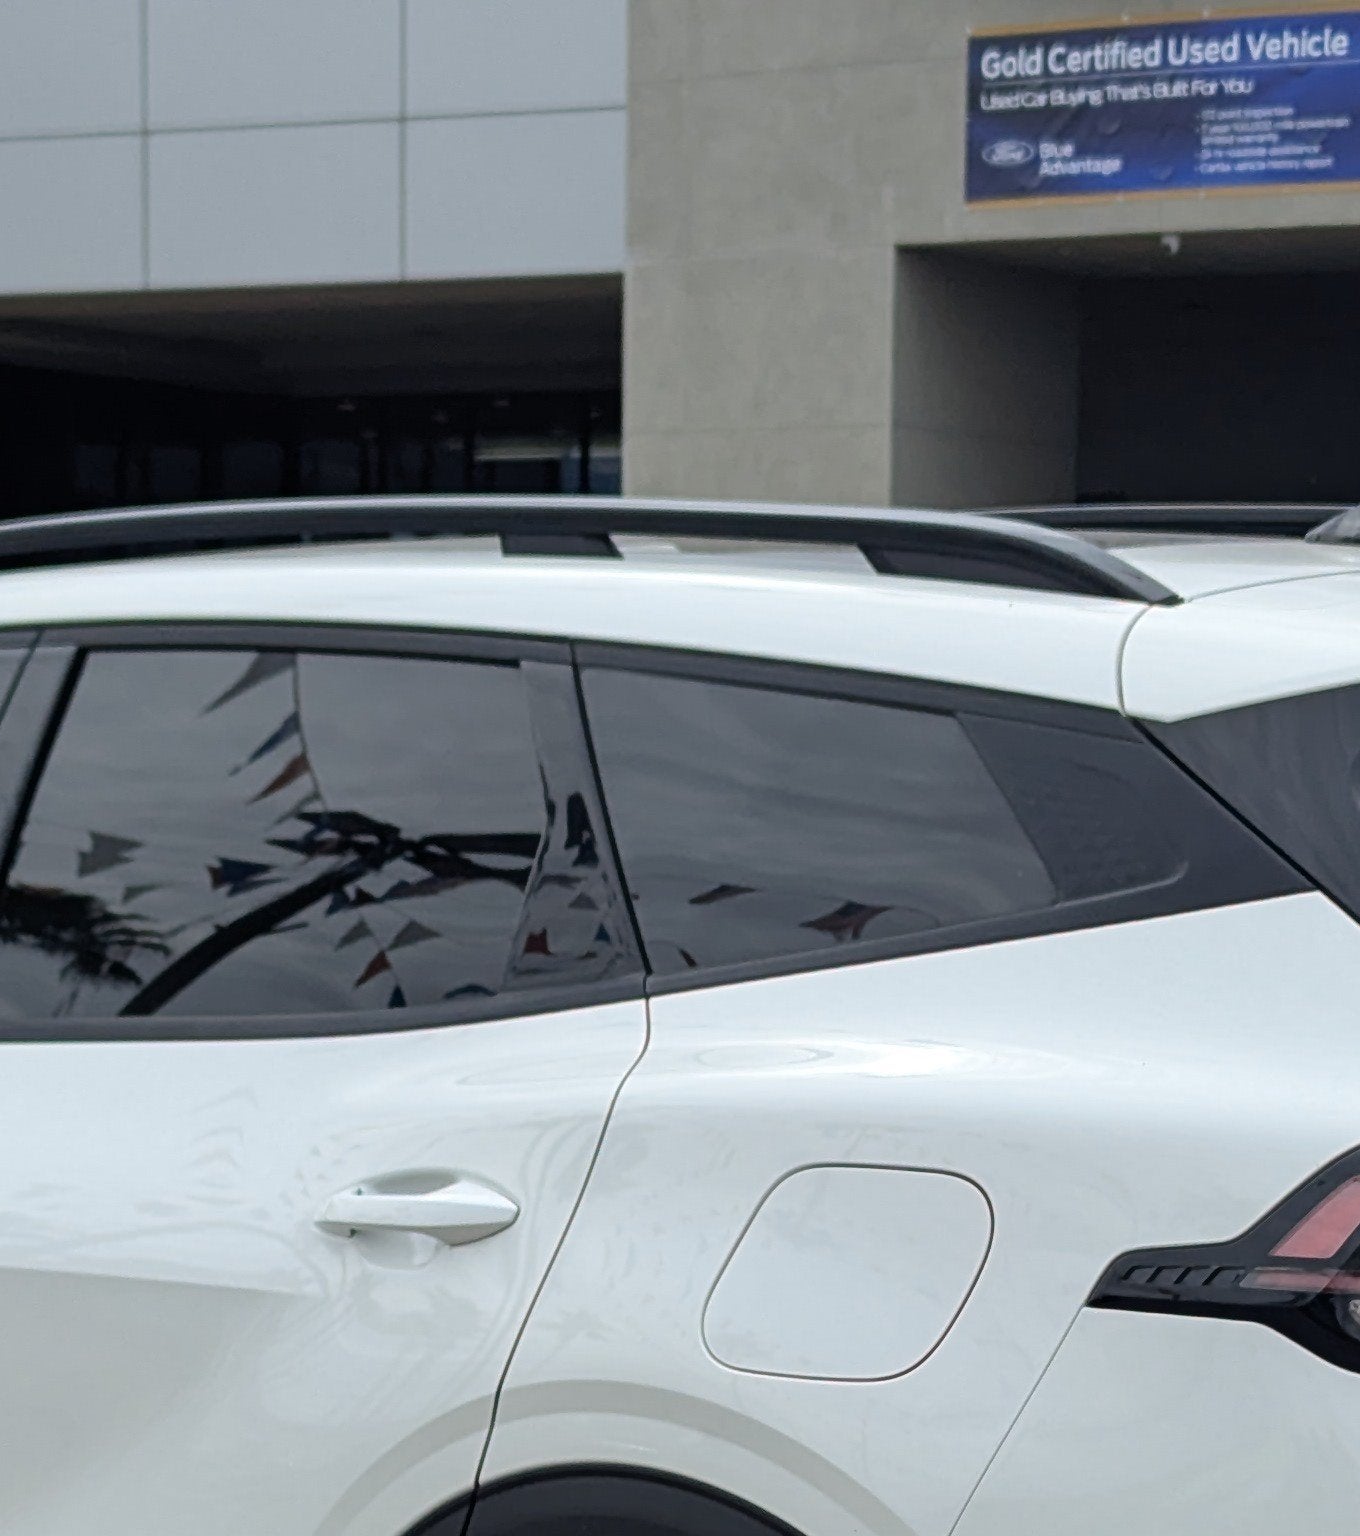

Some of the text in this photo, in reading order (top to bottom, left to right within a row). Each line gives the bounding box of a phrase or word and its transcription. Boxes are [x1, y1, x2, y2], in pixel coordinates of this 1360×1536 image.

[980, 27, 1349, 80] Gold Certified Used Vehicle
